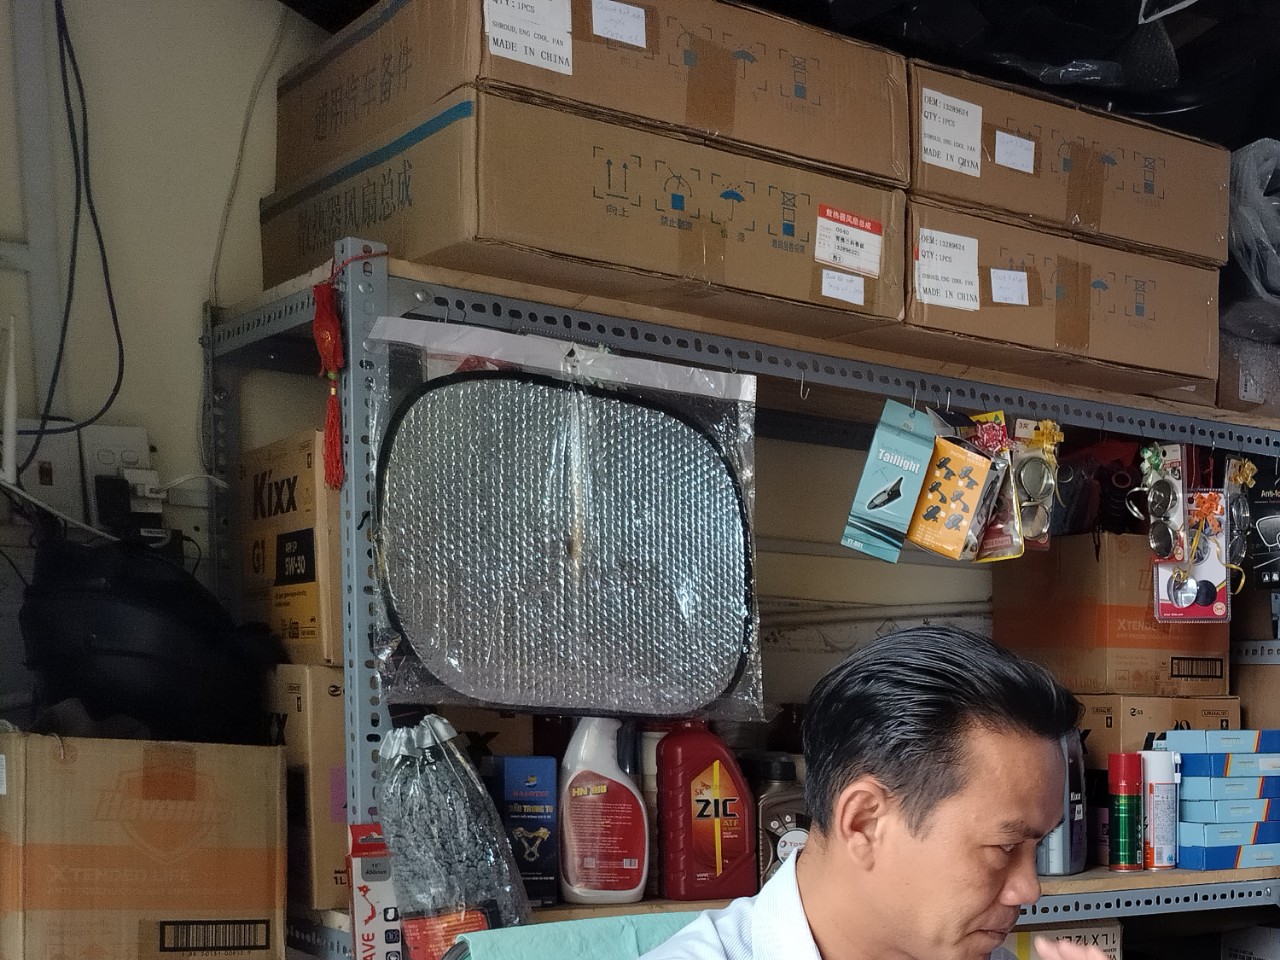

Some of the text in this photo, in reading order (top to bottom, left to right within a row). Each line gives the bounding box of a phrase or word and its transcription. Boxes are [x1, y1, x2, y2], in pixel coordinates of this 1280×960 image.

[492, 36, 571, 67] MADE IN CHINA
[923, 146, 941, 159] MADE
[946, 152, 955, 163] IN
[605, 203, 630, 218] 向上
[922, 286, 978, 303] MADE IN CHINA
[877, 448, 922, 475] Taillight
[253, 469, 298, 521] Kixx
[694, 797, 740, 819] ZIC
